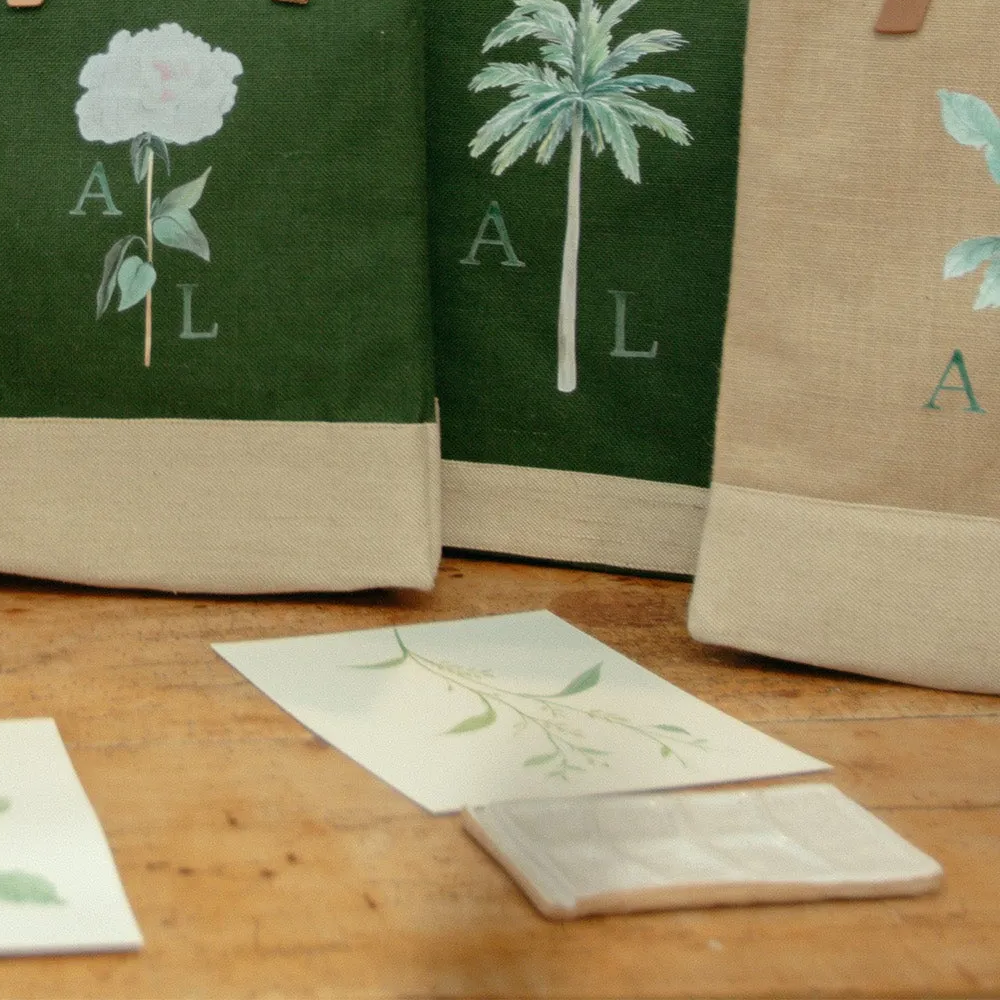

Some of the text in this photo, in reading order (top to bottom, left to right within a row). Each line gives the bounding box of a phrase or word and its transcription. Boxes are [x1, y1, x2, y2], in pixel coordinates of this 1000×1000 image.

[69, 161, 122, 216] A
[459, 201, 525, 267] A
[177, 283, 219, 339] L
[608, 290, 659, 358] L
[922, 349, 987, 414] A
